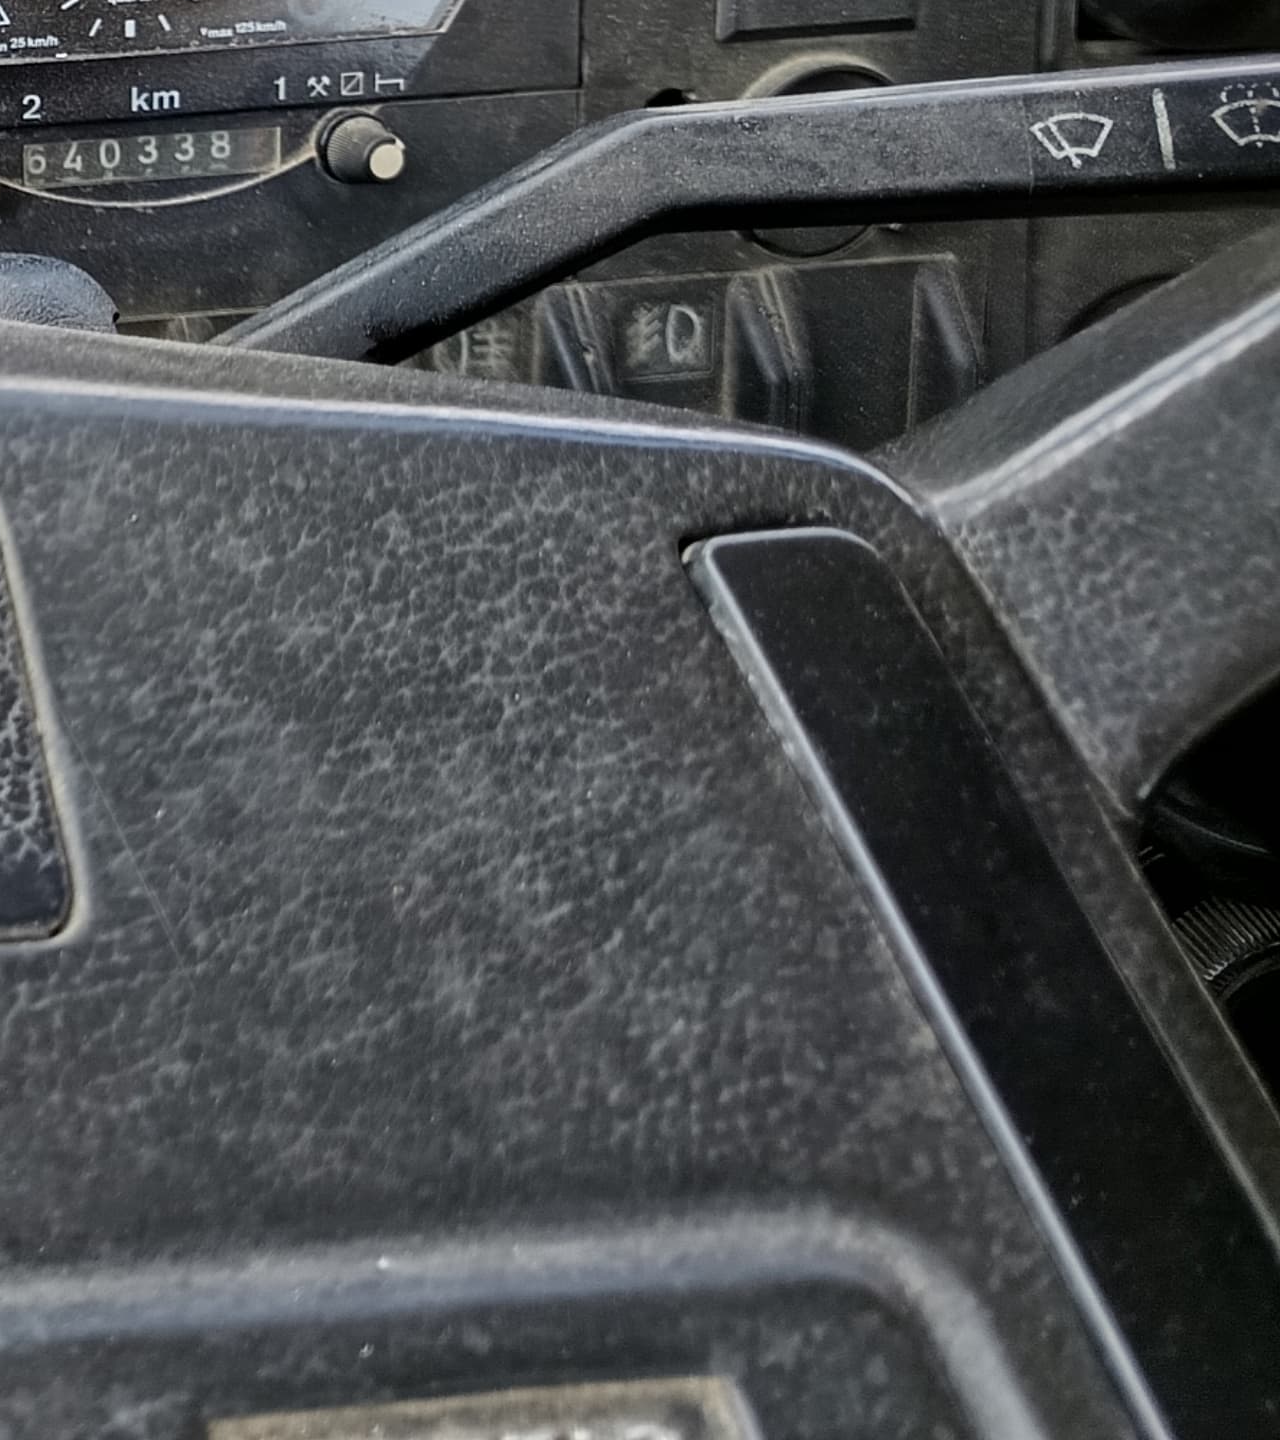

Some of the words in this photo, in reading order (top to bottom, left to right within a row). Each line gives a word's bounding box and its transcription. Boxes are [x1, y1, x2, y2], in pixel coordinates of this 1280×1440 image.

[9, 36, 26, 49] 25
[131, 86, 181, 111] km
[274, 76, 287, 99] 1
[22, 96, 41, 120] 2
